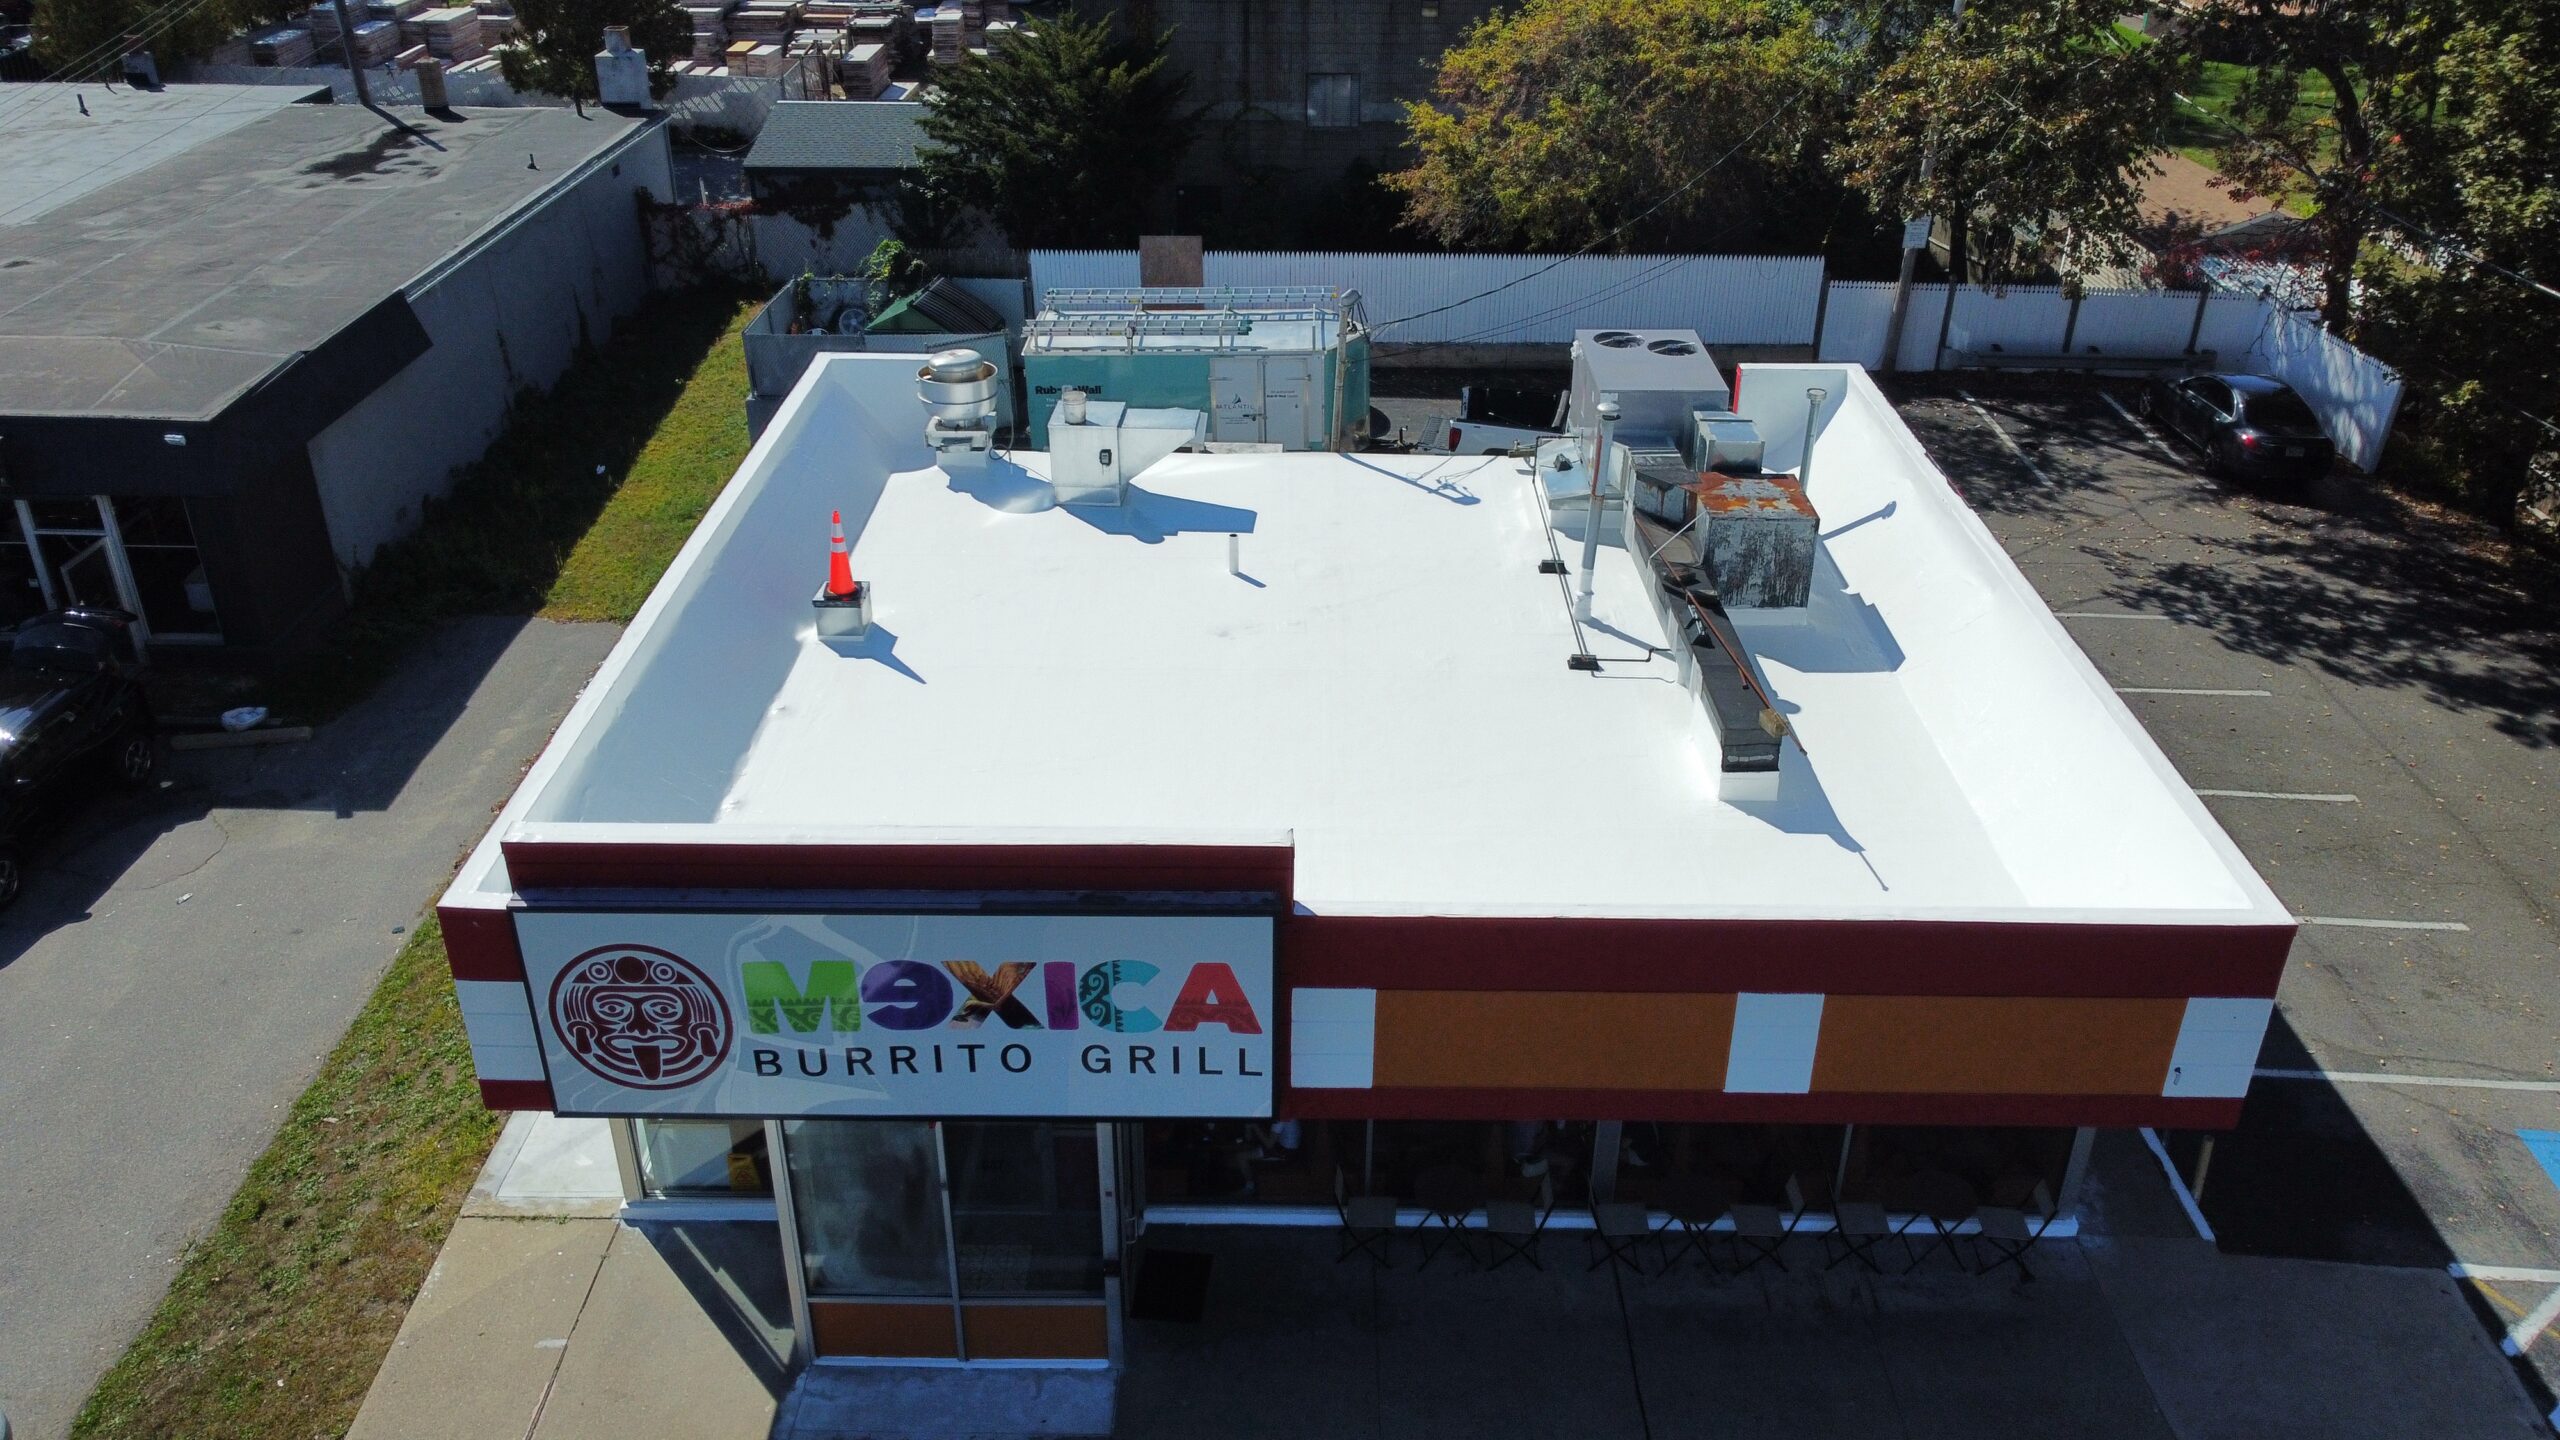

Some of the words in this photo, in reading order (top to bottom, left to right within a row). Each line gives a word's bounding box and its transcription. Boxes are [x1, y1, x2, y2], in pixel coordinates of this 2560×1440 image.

[1035, 385, 1102, 395] Rub--Wall
[753, 1043, 1032, 1077] BURRITO
[1081, 1044, 1263, 1077] GRILL
